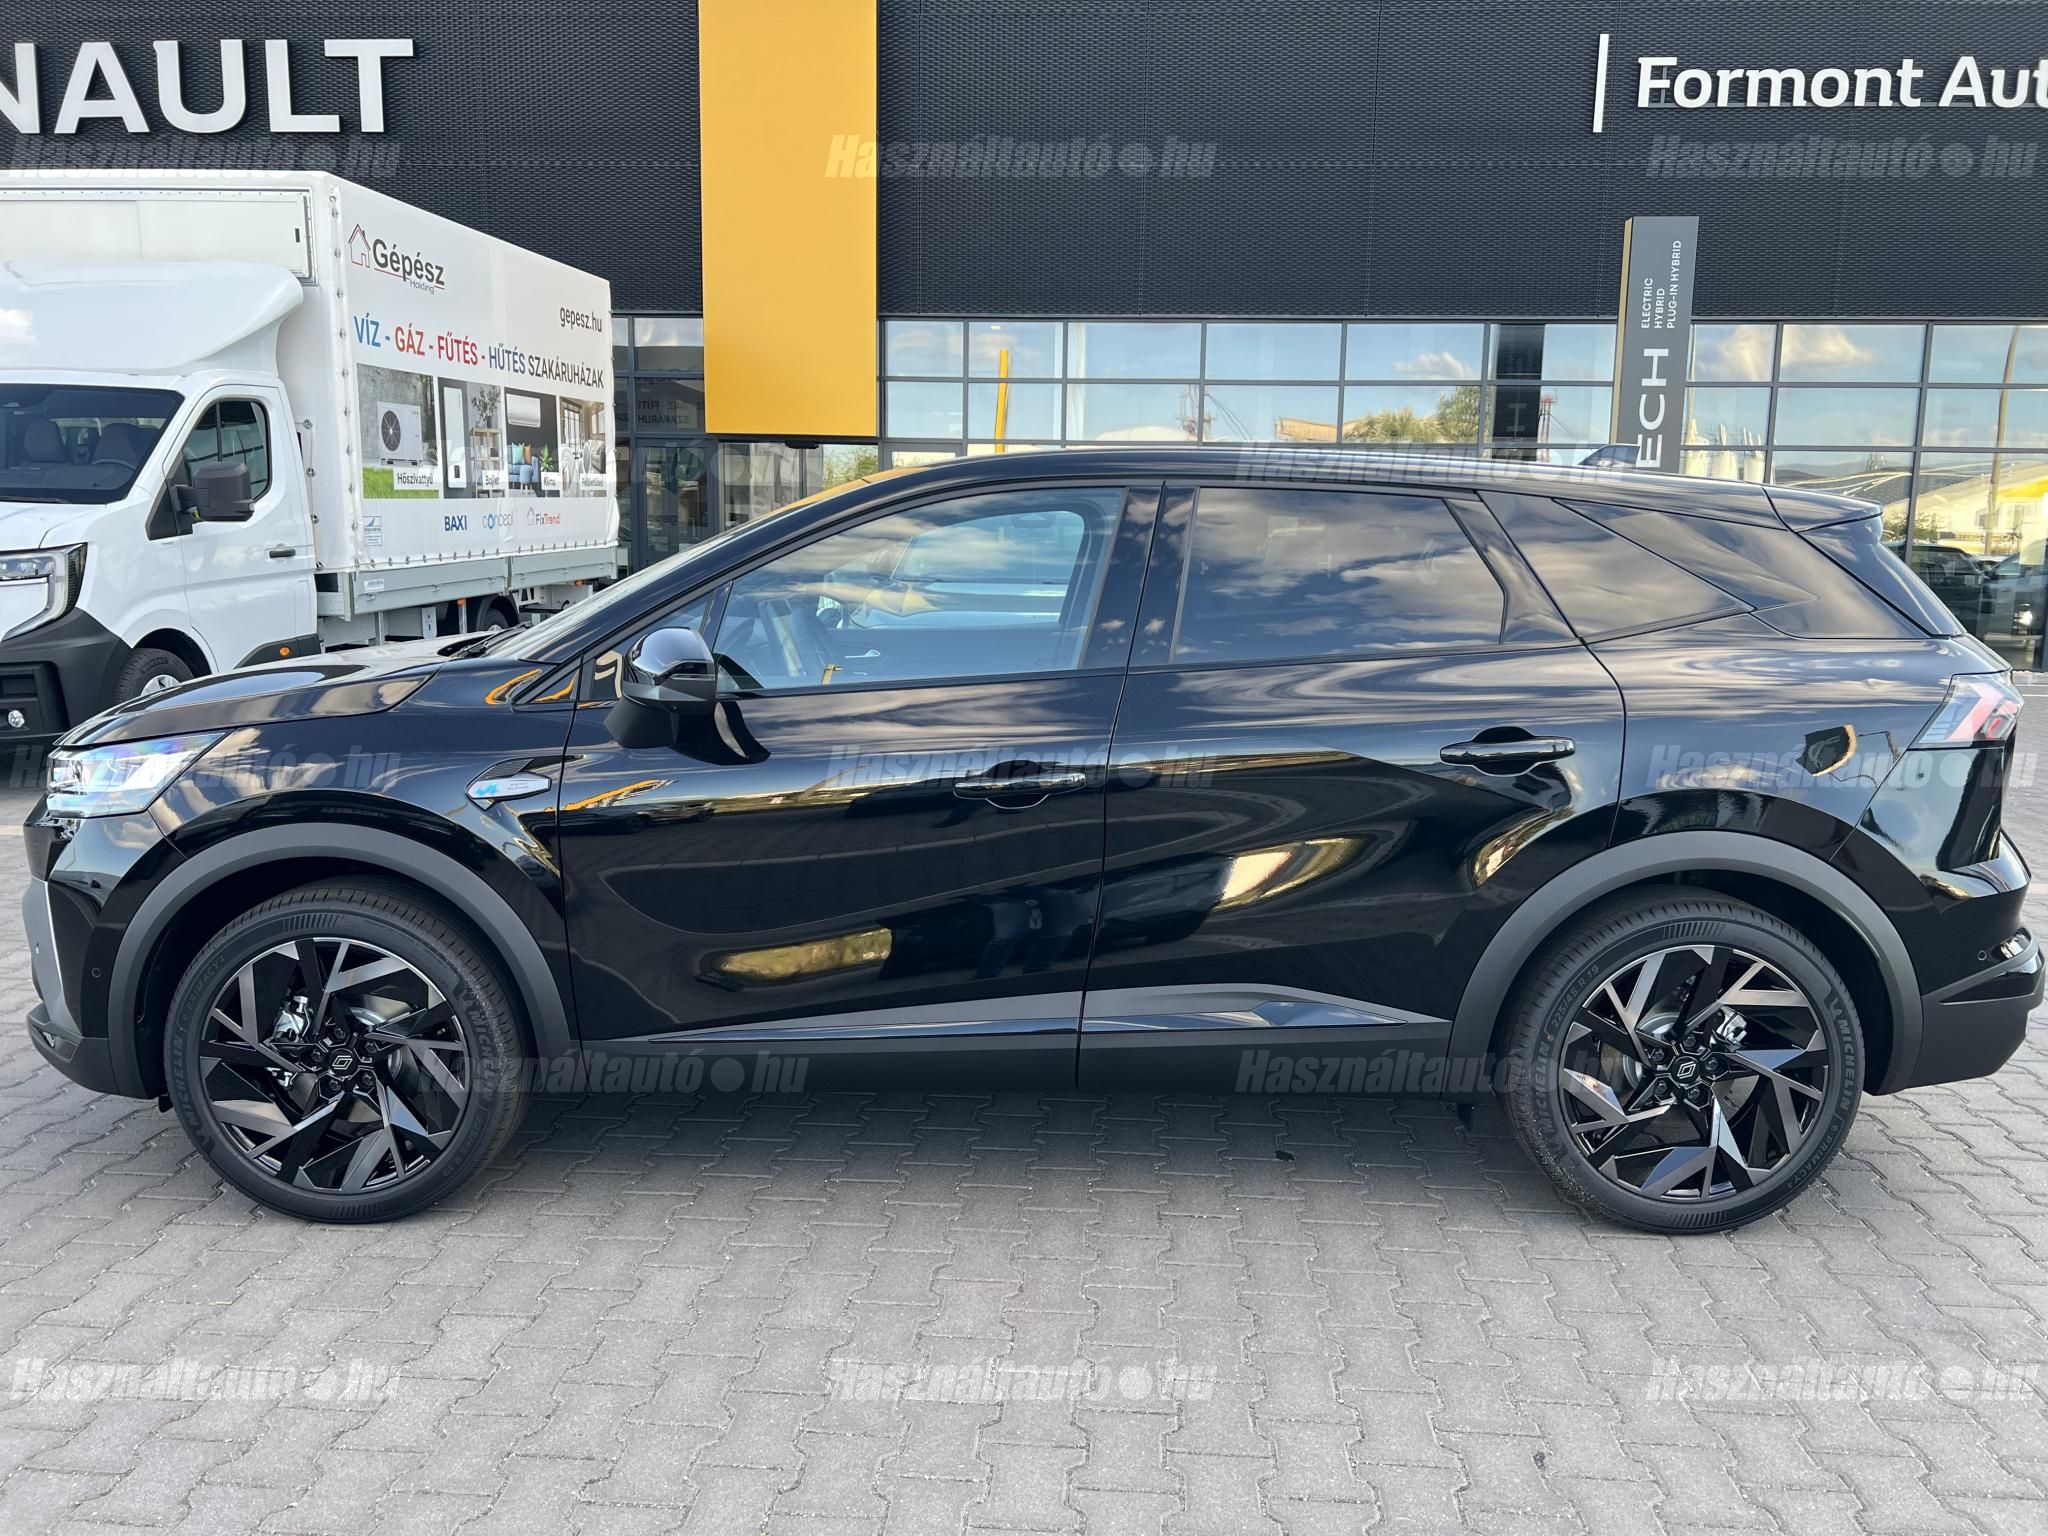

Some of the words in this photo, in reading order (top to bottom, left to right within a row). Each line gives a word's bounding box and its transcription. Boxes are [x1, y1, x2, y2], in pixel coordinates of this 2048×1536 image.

[1637, 56, 1924, 109] Formont
[1938, 55, 2048, 109] Aut
[372, 238, 445, 286] Gépész
[1670, 240, 1682, 281] HYBRID
[410, 279, 435, 295] Holding
[1641, 277, 1653, 329] ELECTRIC
[1654, 288, 1666, 329] HYBRID
[1666, 284, 1679, 329] PLUG-IN
[560, 306, 603, 333] gepesz.hu
[353, 312, 382, 348] VÍZ
[394, 322, 426, 356] GÁZ
[437, 331, 479, 366] FŰTÉS
[488, 342, 526, 375] HŰTÉS
[528, 355, 604, 389] SZAKÁRUHÁZAK
[444, 515, 468, 532] BAXI
[535, 513, 561, 526] FixTrend
[1578, 977, 1588, 988] R
[173, 1034, 201, 1126] MICHELIN
[1837, 1018, 1855, 1112] MICHELIN
[1794, 1134, 1833, 1184] PRIMACY
